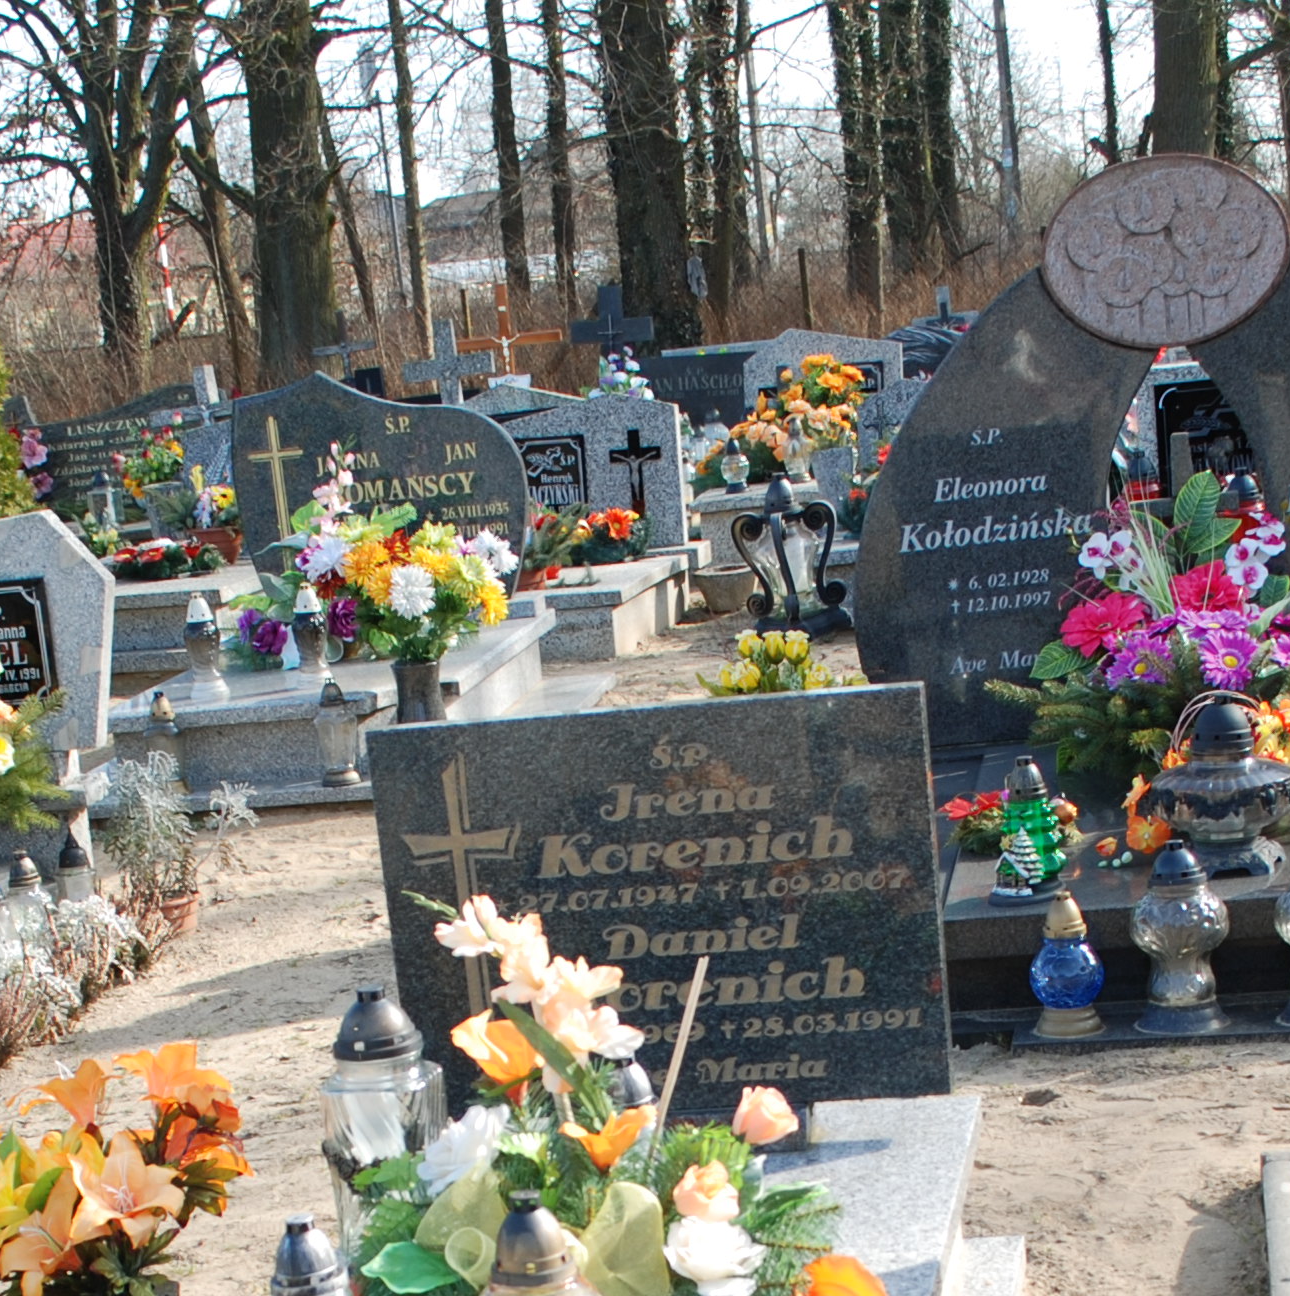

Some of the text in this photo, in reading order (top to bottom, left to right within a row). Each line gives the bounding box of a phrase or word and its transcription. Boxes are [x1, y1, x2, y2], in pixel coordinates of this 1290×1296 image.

[384, 412, 411, 436] Ś.P.
[970, 424, 1004, 446] Ś.P.
[444, 441, 478, 466] JAN
[68, 478, 93, 489] Józe
[529, 483, 582, 505] ACZYŃSKI
[933, 474, 1049, 504] Eleonora
[441, 501, 510, 521] 26.VIII.1935
[898, 507, 1093, 554] Kołodzińska
[966, 590, 1052, 614] 12.10.1997
[949, 649, 1039, 676] Ave Mar
[537, 814, 854, 880] Korenich
[519, 868, 909, 914] 27.07.1947 1.09.2007
[602, 912, 801, 960] Daniel
[606, 955, 867, 1013] orenich
[742, 1007, 923, 1039] 28.03.1991
[697, 1053, 829, 1085] Maria
